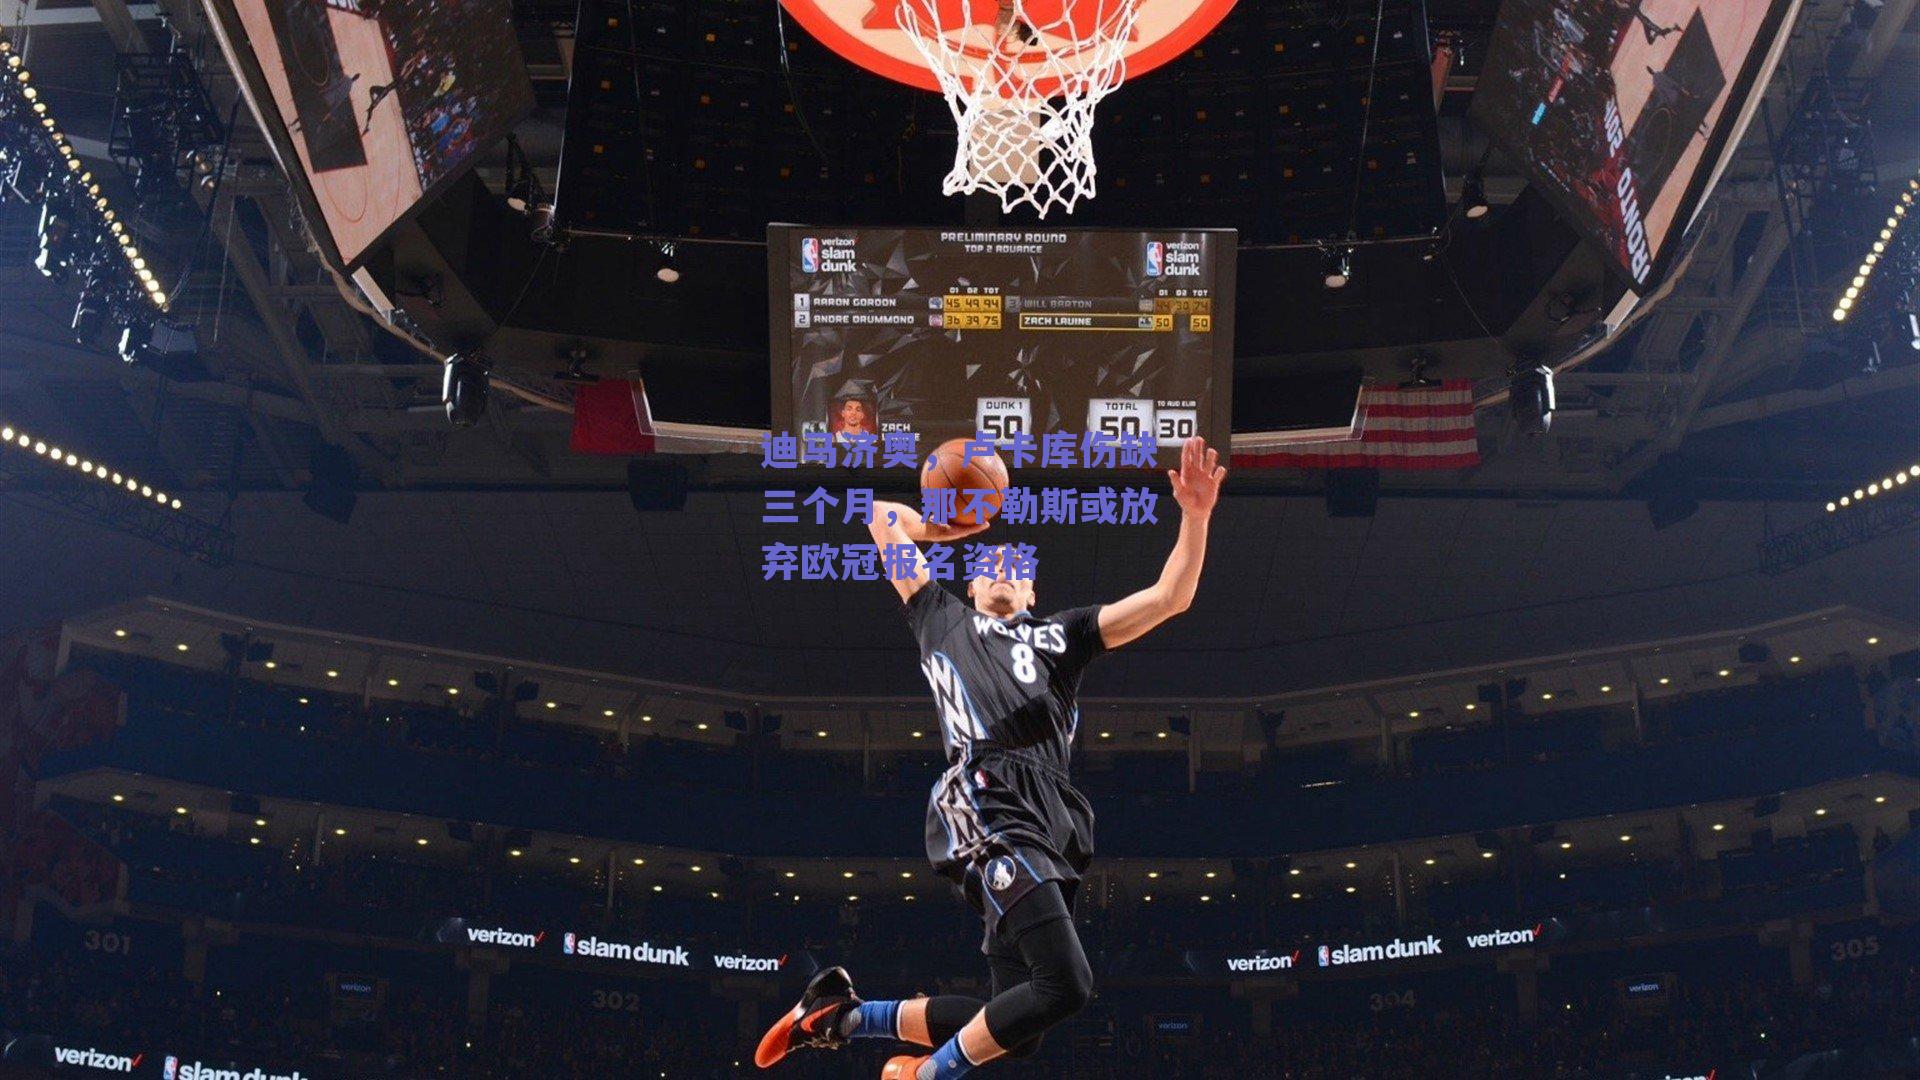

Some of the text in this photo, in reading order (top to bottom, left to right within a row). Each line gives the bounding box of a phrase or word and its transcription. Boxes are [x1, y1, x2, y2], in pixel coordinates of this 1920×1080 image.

[821, 238, 855, 246] verizon
[941, 232, 1067, 243] PRELIMINARY ROUND
[965, 245, 1043, 254] TOP 2 ADVANCE
[1166, 242, 1199, 250] verizon
[821, 247, 855, 260] slam
[1165, 251, 1200, 263] slam
[821, 260, 857, 272] dunk
[1165, 264, 1200, 276] dunk
[1193, 289, 1208, 297] TOT
[813, 298, 850, 306] AARON
[853, 298, 897, 307] GORDON
[946, 299, 960, 308] 45
[965, 299, 980, 308] 49
[984, 299, 999, 308] 94
[800, 315, 999, 325] 2 ANDRE DRUMMOND 36 39 75
[1024, 317, 1052, 325] ZACH
[1156, 318, 1170, 327] 50
[1193, 318, 1208, 327] 50
[986, 401, 1015, 410] DUNK
[1106, 402, 1138, 411] TOTAL
[881, 423, 911, 432] ZACH
[983, 415, 1023, 440] 50
[1100, 416, 1140, 442] 50
[1160, 418, 1193, 438] 30
[973, 616, 1067, 654] WOLVES
[1011, 643, 1036, 684] 8
[84, 929, 131, 954] 301
[467, 927, 536, 948] verizon
[1467, 929, 1534, 949] verizon
[577, 936, 690, 966] slam dunk
[1331, 935, 1443, 965] slam dunk
[1830, 935, 1879, 961] 305
[714, 954, 779, 971] verizon
[1227, 954, 1292, 972] verizon
[340, 982, 372, 994] verizon
[1629, 982, 1661, 993] verizon
[55, 1047, 132, 1072] verizon
[178, 1061, 240, 1080] slam
